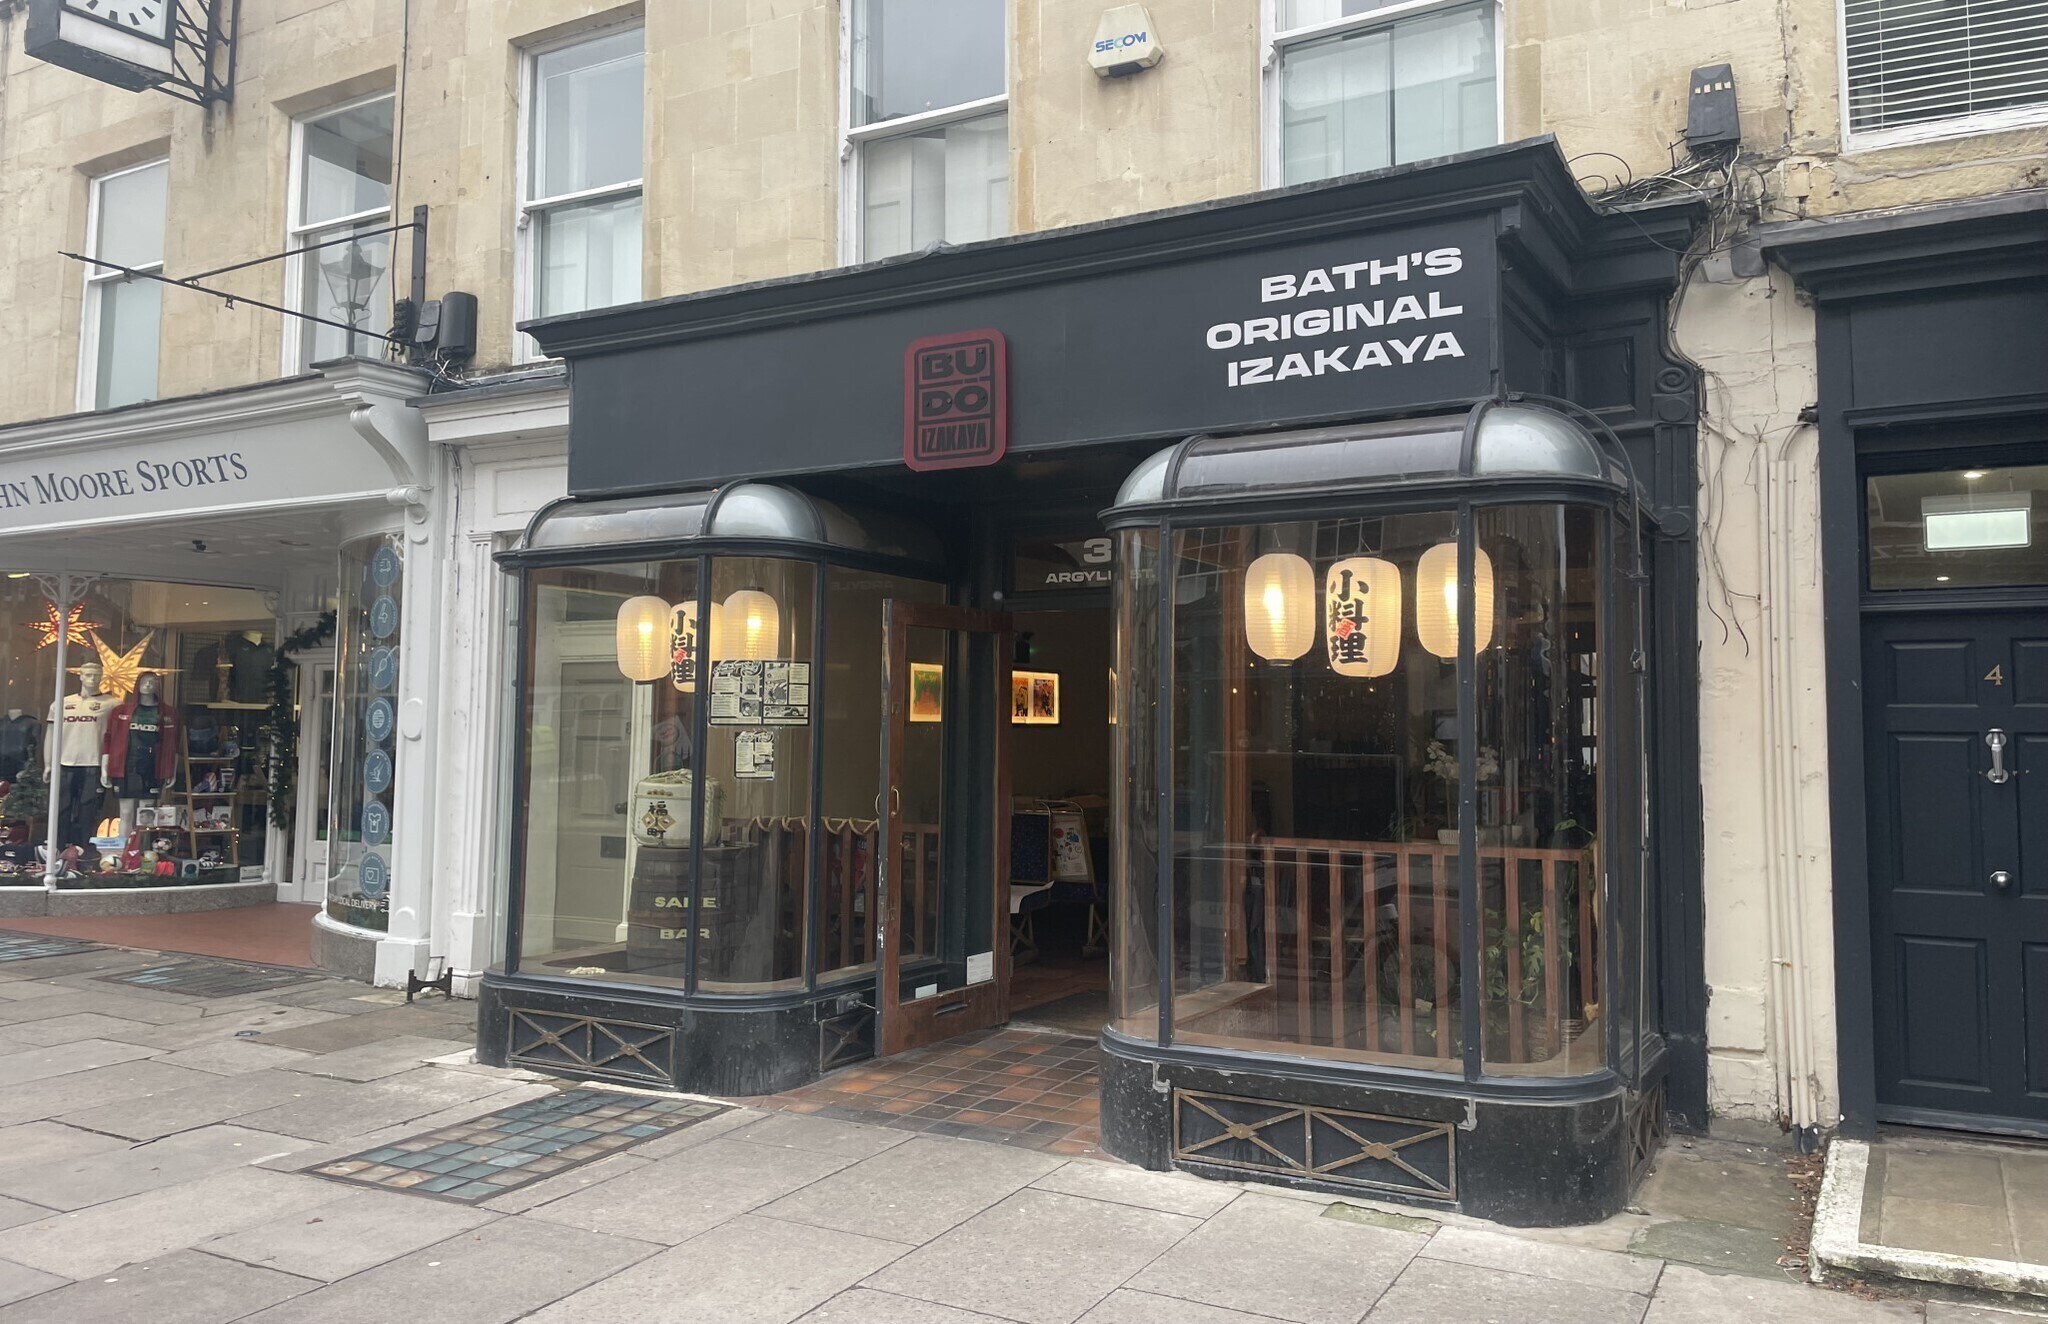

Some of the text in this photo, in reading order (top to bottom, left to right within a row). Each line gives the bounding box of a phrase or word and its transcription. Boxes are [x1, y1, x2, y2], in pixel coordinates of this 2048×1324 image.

[1095, 31, 1147, 53] SECOM
[1261, 247, 1463, 303] BATH'S
[1206, 291, 1463, 350] ORIGINAL
[921, 346, 987, 380] BU
[1228, 331, 1466, 388] IZAKAYA
[921, 385, 989, 418] DO
[921, 422, 987, 454] IZAKAYA
[32, 469, 135, 505] MOORE
[136, 452, 248, 492] SPORTS
[1083, 537, 1112, 564] 3
[1328, 569, 1370, 664] 小料理
[1983, 664, 2003, 686] 4
[654, 896, 717, 909] SAE
